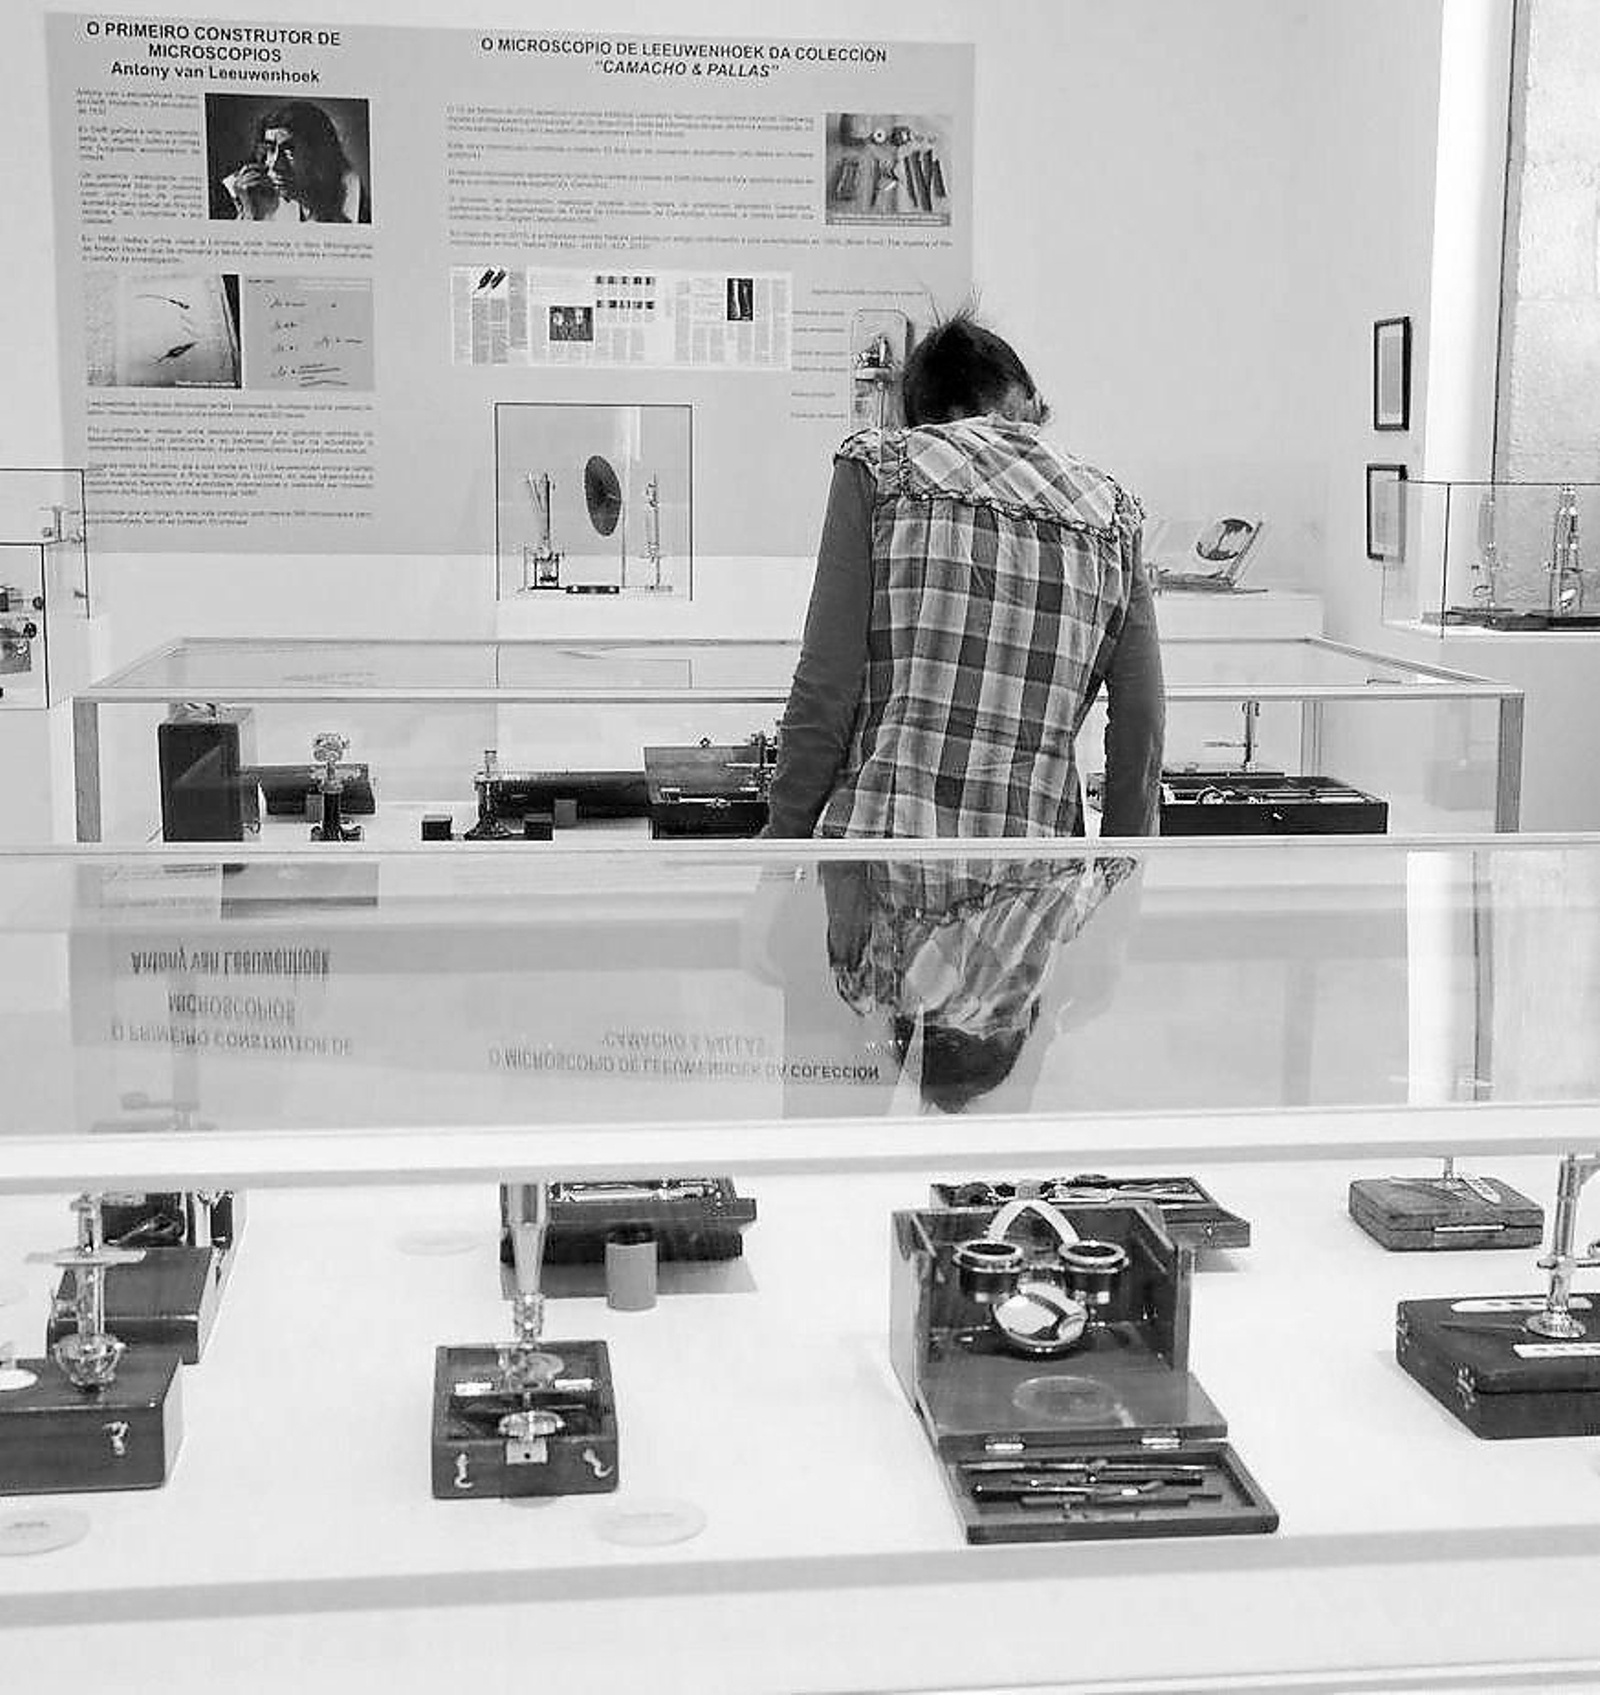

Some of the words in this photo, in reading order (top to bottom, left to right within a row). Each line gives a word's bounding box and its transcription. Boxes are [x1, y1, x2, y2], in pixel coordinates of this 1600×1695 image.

[86, 21, 100, 36] O
[104, 22, 190, 39] PRIMEIRO
[195, 26, 313, 44] CONSTRUTOR
[318, 32, 341, 46] DE
[148, 44, 282, 62] MICROSCOPIOS
[481, 37, 493, 50] O
[498, 38, 612, 55] MICROSCOPIO
[616, 42, 638, 56] DE
[642, 43, 765, 59] LEEUWENHOEK
[769, 46, 791, 60] DA
[111, 61, 170, 80] Antony
[174, 66, 204, 80] van
[209, 66, 321, 83] Leeuwenhoek
